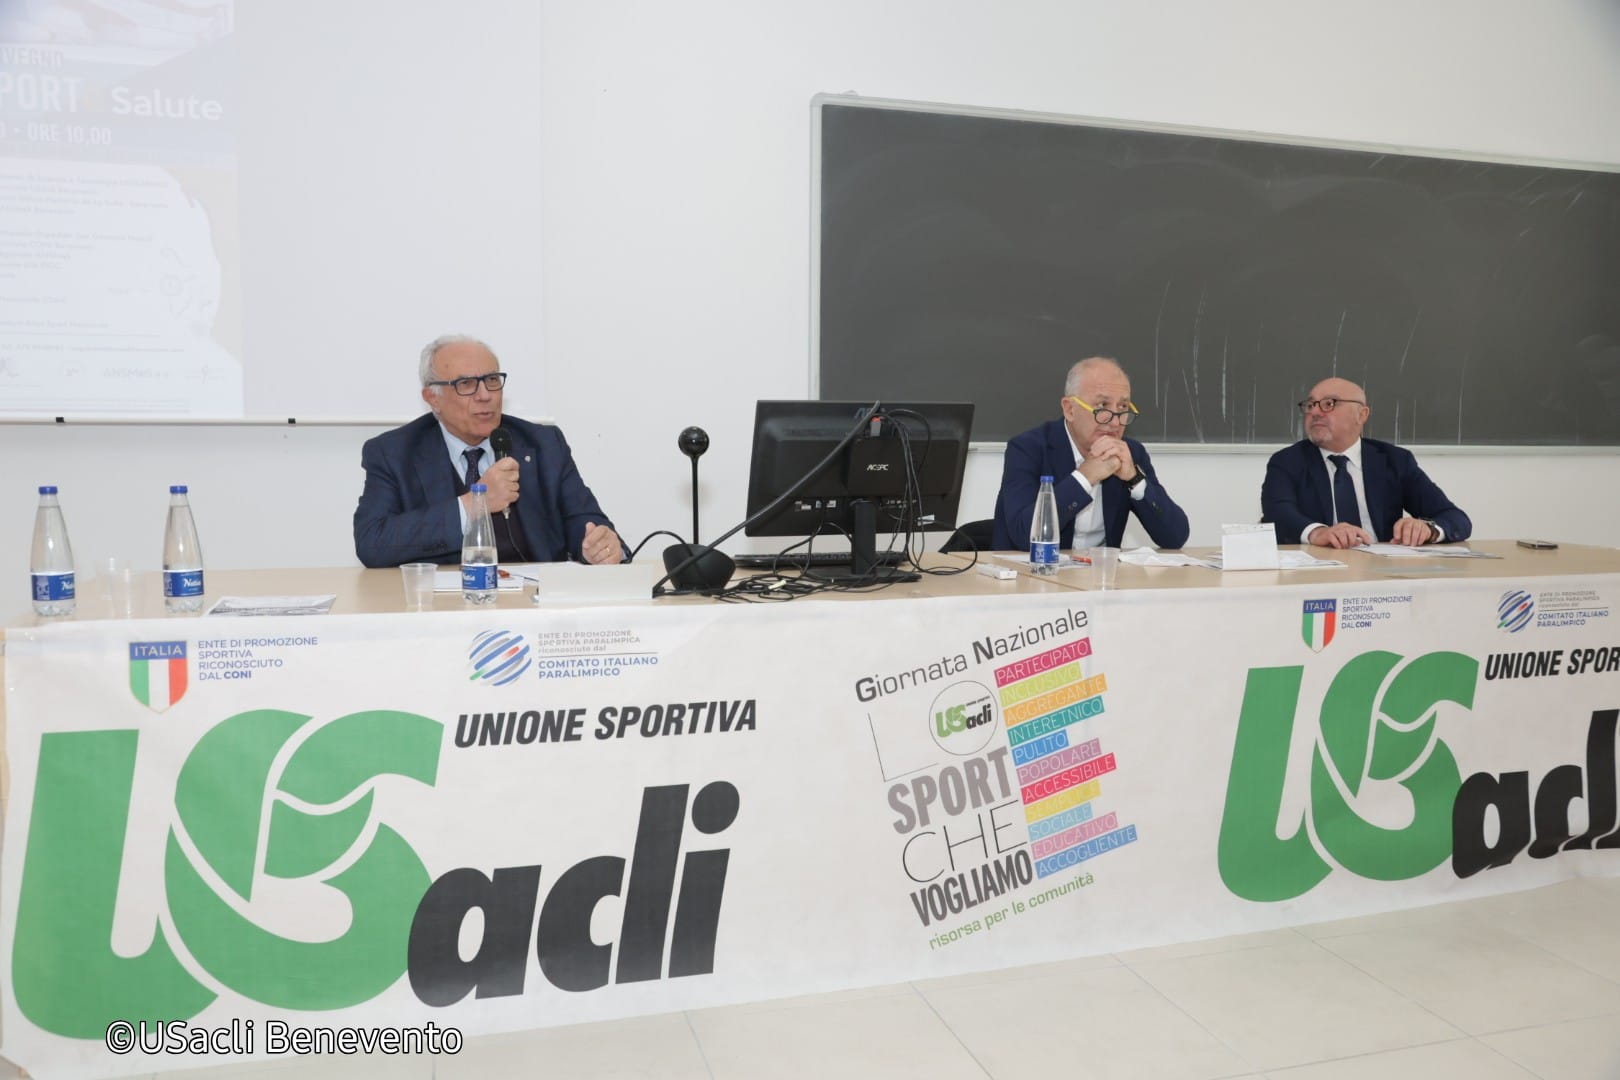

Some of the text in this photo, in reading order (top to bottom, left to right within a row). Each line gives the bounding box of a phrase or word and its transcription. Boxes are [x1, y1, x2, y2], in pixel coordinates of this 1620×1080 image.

[112, 86, 224, 120] Salute
[1305, 601, 1335, 612] ITALIA
[1342, 605, 1374, 613] SPORTIVA
[1369, 595, 1413, 604] PROMOZIONE
[1341, 612, 1391, 621] RICONOSCIUTO
[1537, 610, 1609, 621] COMITATO ITALIANO
[1537, 619, 1586, 628] PARALIMPICO
[198, 636, 319, 649] ENTE DI PROMOZIONE
[538, 630, 632, 640] ENTE DI PROMOZIONE
[583, 637, 641, 645] PARALIMPICA
[134, 644, 184, 658] ITALIA
[198, 649, 253, 659] SPORTIVA
[199, 658, 283, 670] RICONOSCIUTO
[538, 656, 659, 670] COMITATO ITALIANO
[855, 608, 1089, 703] Giornata Nazionale
[996, 641, 1090, 683] PARTECIPATO
[1484, 650, 1563, 680] UNIONE
[199, 670, 252, 681] DAL CONI
[538, 668, 621, 680] PARALIMPICO
[1001, 666, 1081, 704] INCLUSIVO
[1004, 678, 1104, 725] AGGREGANTE
[454, 699, 757, 748] UNIONE SPORTIVA
[1009, 698, 1102, 745] INTERETNICO
[1013, 733, 1067, 763] PULITO
[1019, 741, 1101, 781] POPOLARE
[887, 746, 1012, 834] SPORT
[1023, 757, 1115, 801] ACCESSIBILE
[1029, 804, 1092, 840] SOCIALE
[1032, 813, 1118, 858] EDUCATIVO
[903, 800, 1028, 882] CHE
[1038, 827, 1137, 876] ACCOGLIENTE
[910, 849, 1033, 927] VOGLIAMO
[928, 871, 1095, 950] risorsa per le comunità
